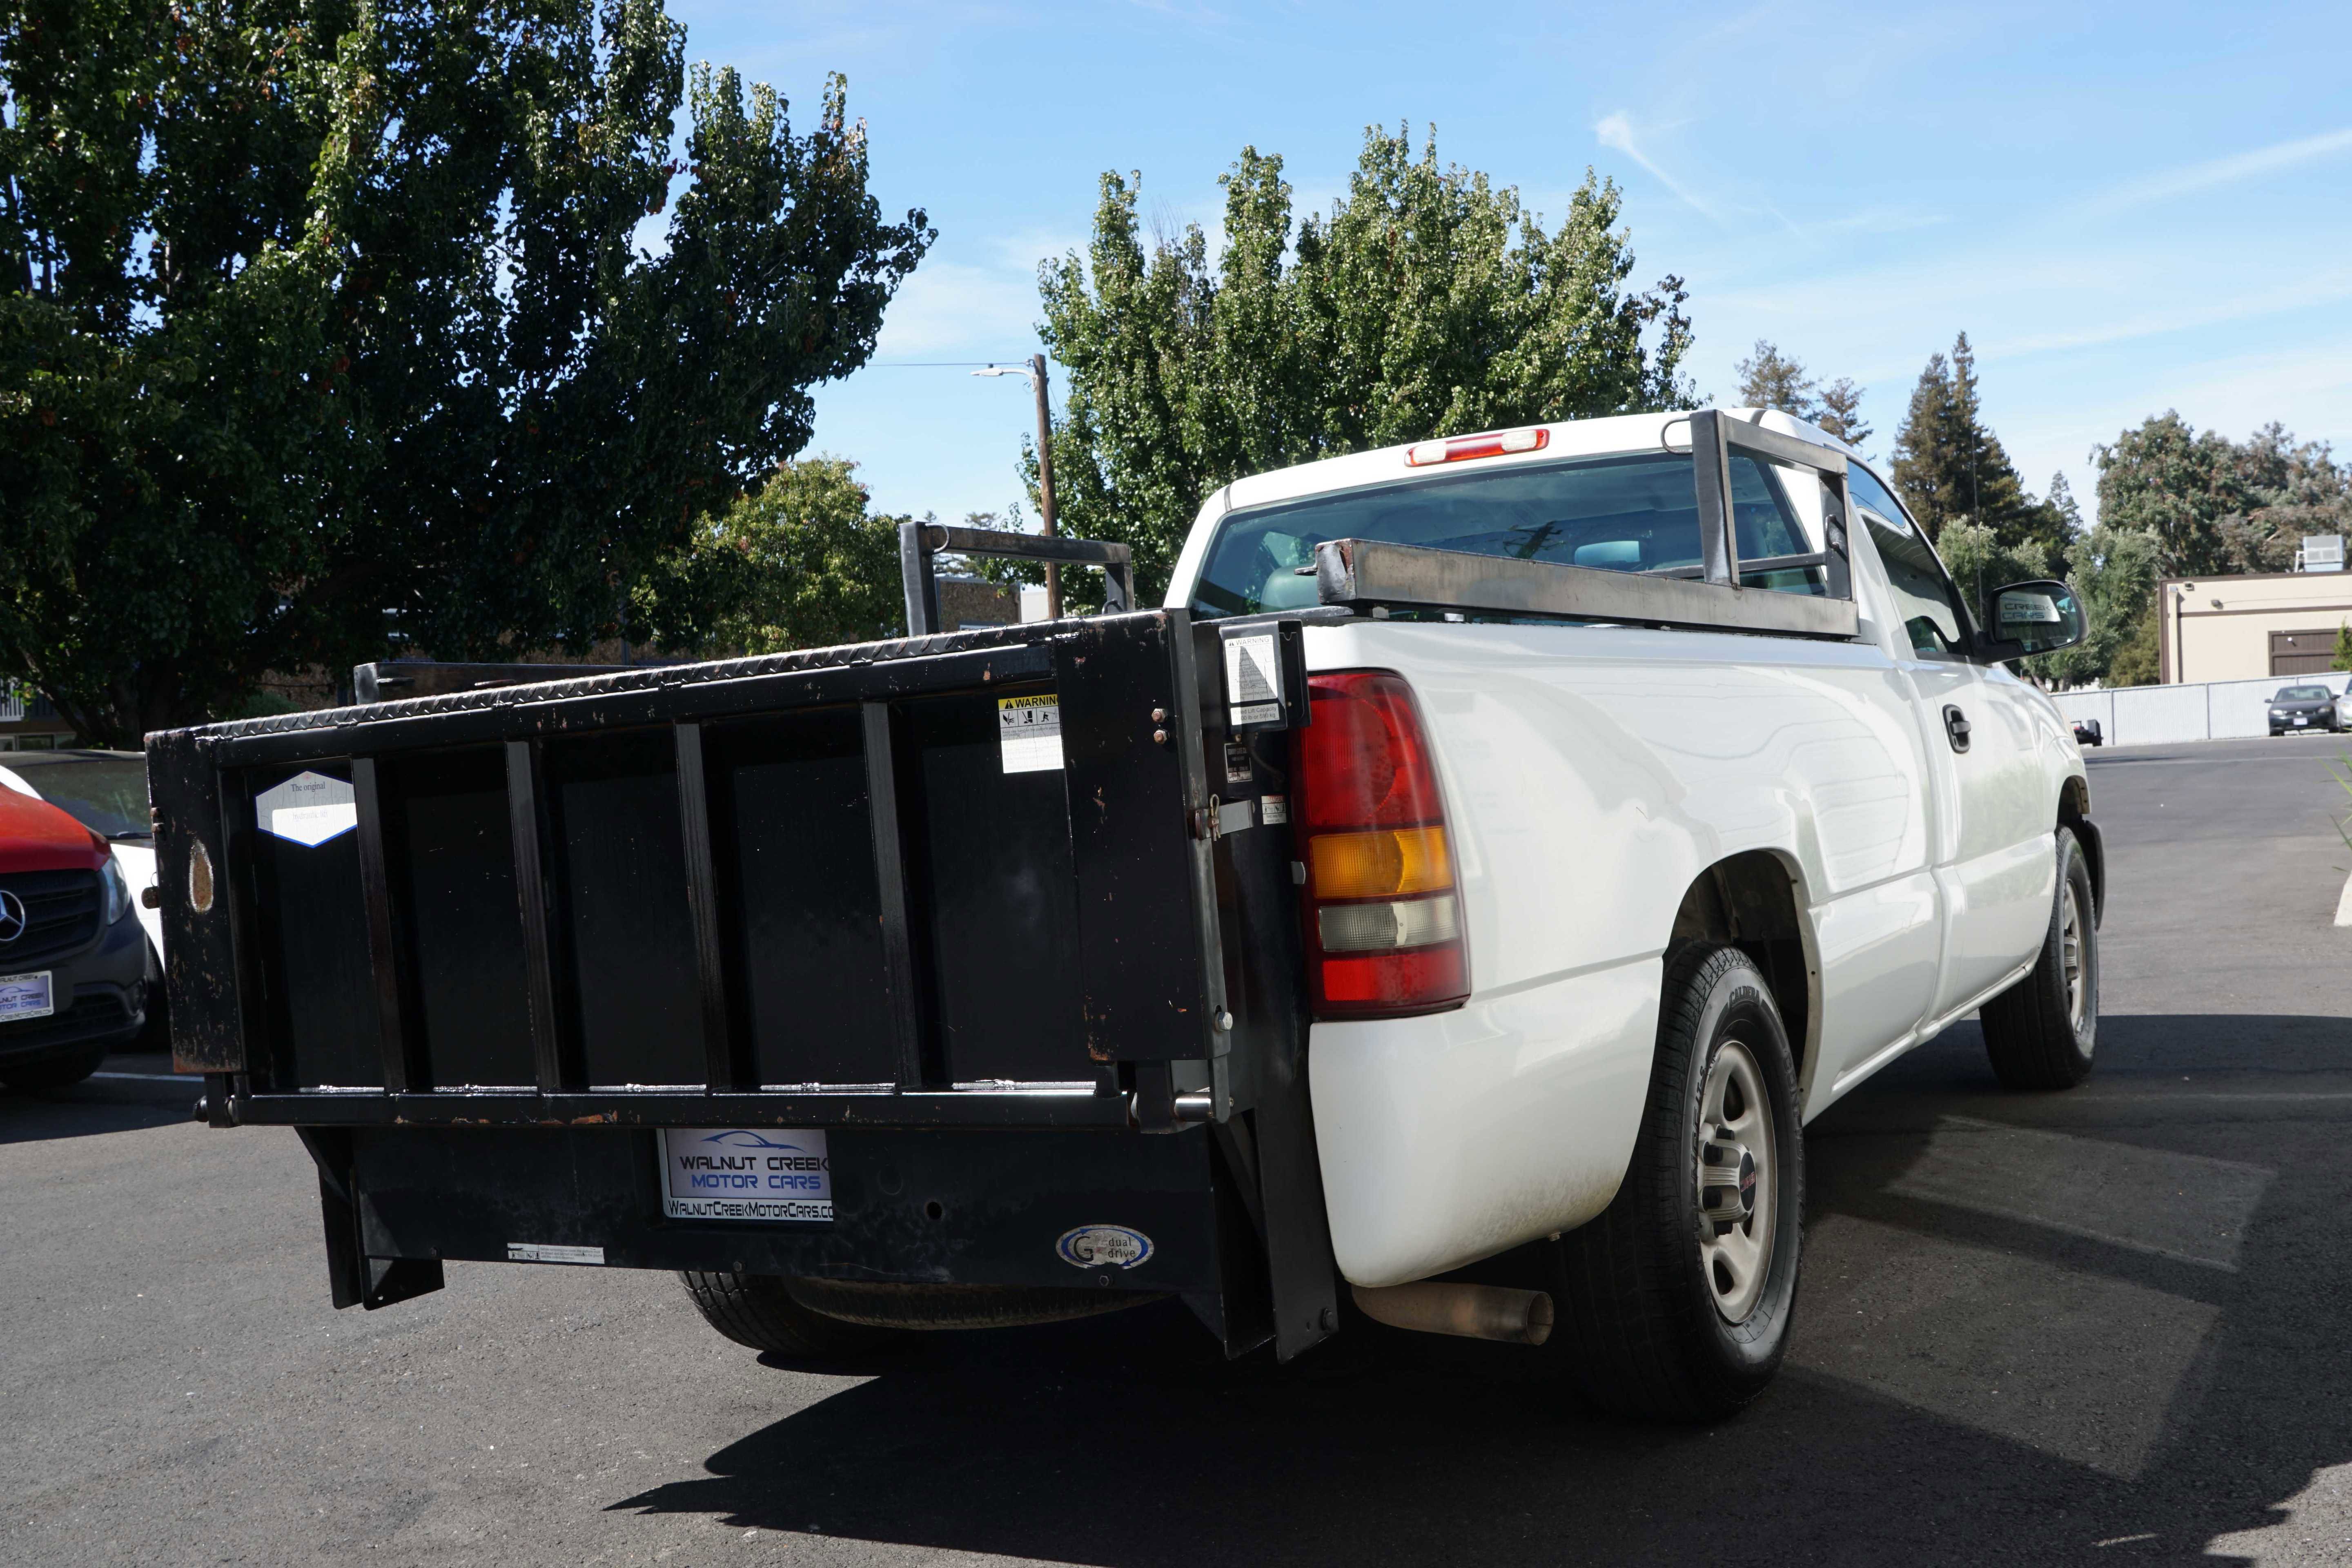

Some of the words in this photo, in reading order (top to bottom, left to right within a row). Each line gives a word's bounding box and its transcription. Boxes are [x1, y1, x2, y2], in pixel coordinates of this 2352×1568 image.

[1236, 637, 1269, 645] WARNING
[1015, 696, 1058, 708] WARNIN
[291, 784, 303, 792] The
[303, 782, 325, 792] original
[679, 1156, 757, 1170] WALNUT
[767, 1157, 829, 1171] CREEK
[691, 1174, 758, 1188] MOTOR
[768, 1175, 821, 1189] CARS
[668, 1200, 834, 1218] WALNUTCREEKMOTORCARS.CO
[1109, 1237, 1132, 1247] dual
[1108, 1249, 1136, 1258] drive
